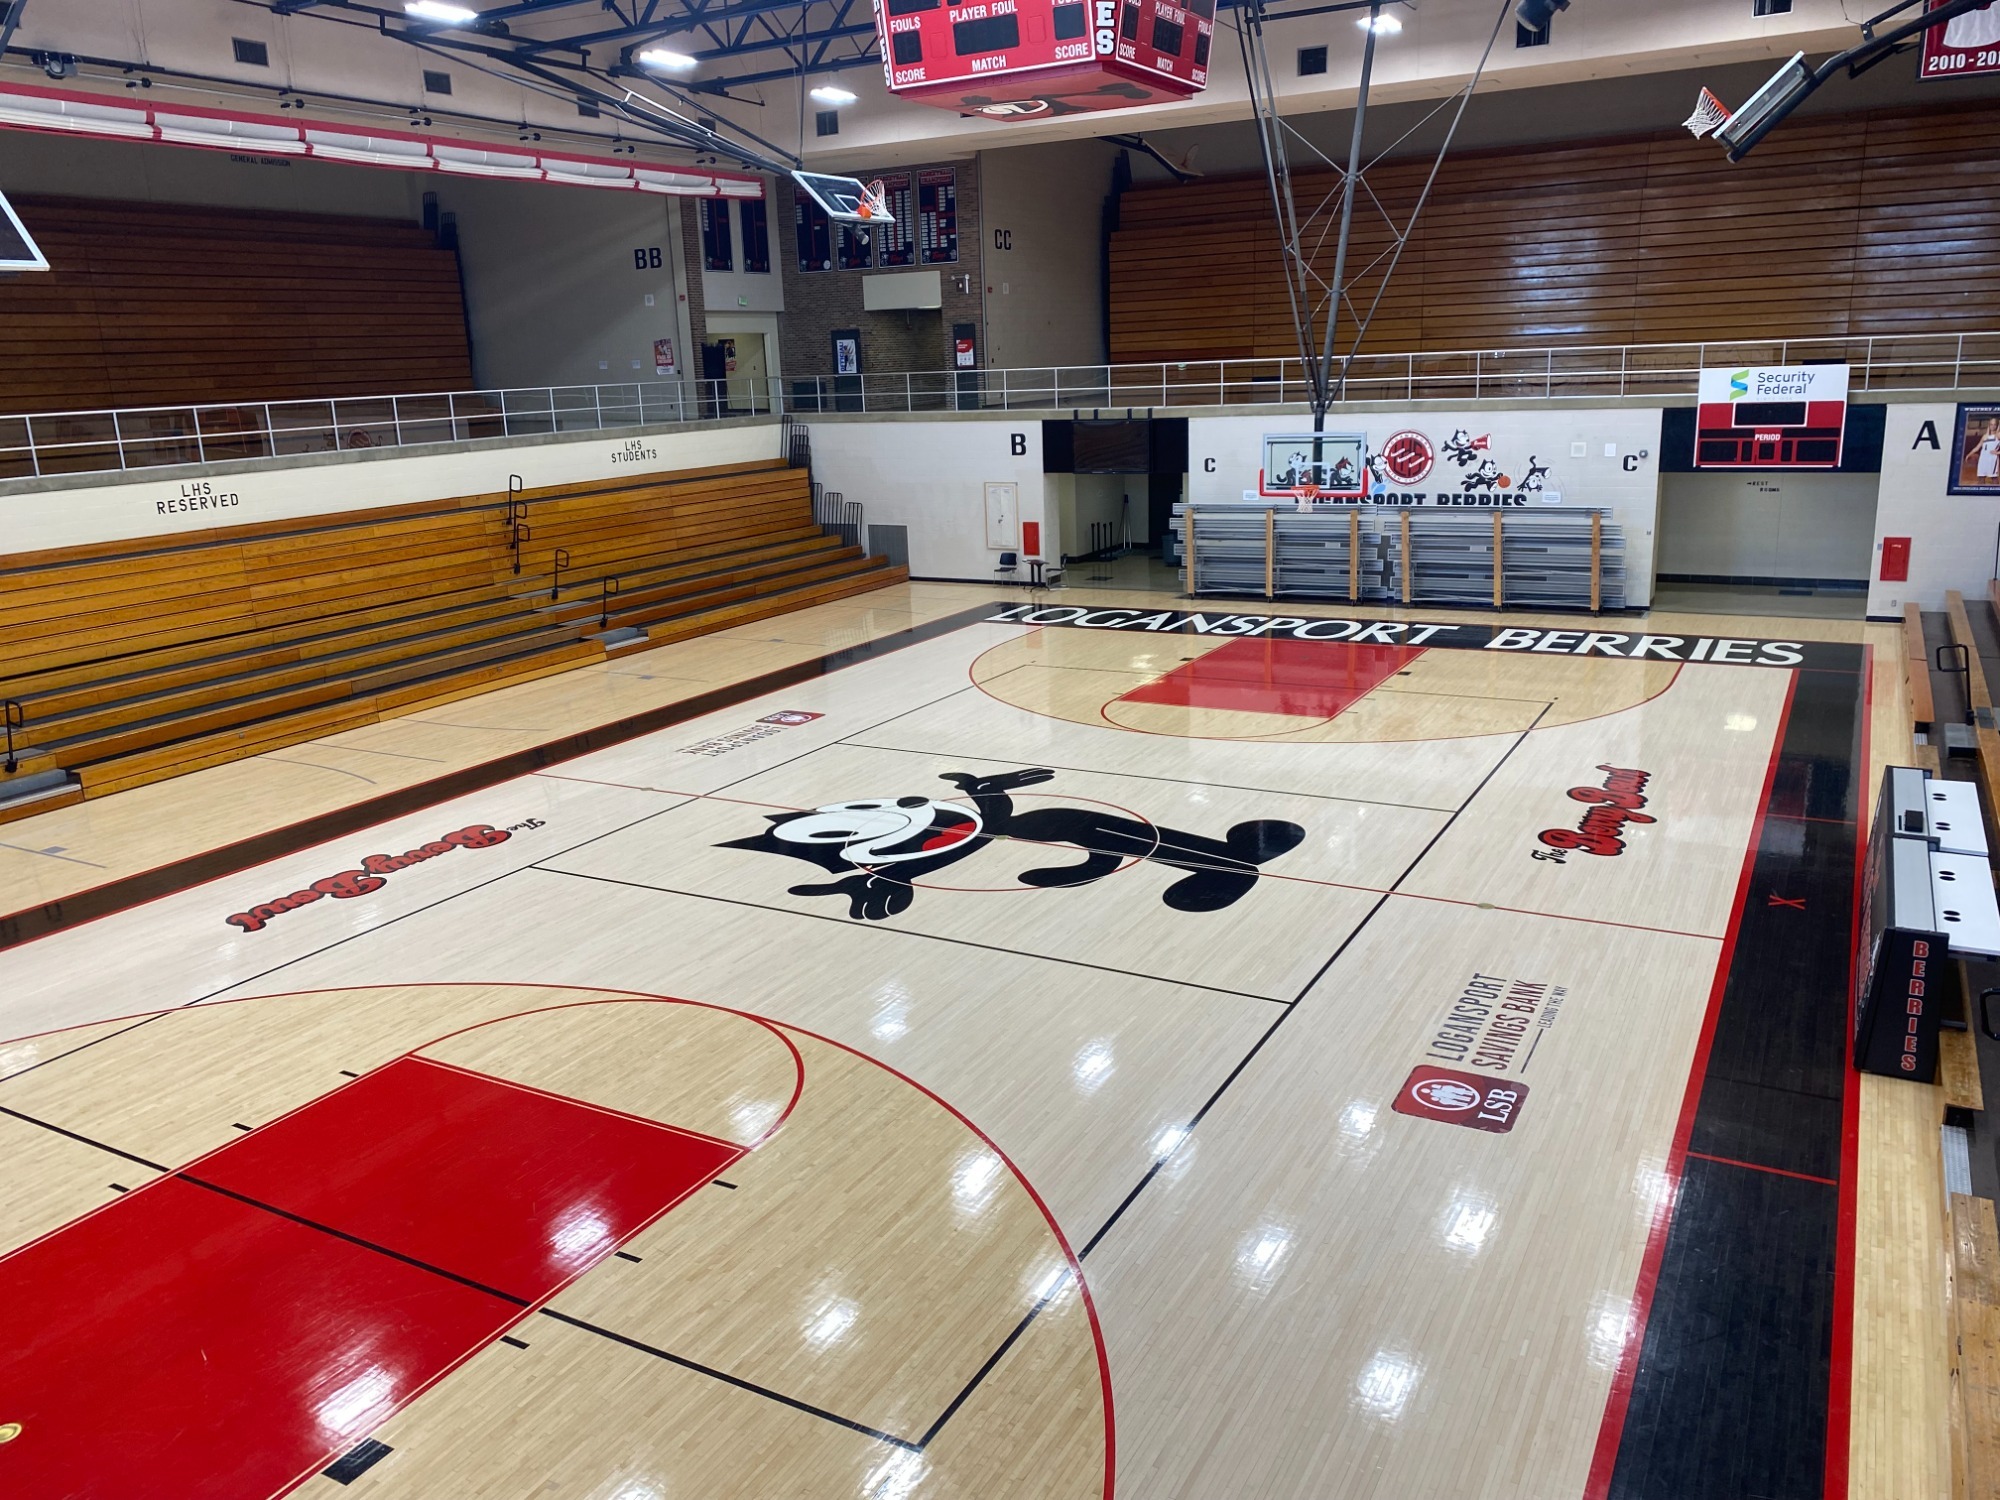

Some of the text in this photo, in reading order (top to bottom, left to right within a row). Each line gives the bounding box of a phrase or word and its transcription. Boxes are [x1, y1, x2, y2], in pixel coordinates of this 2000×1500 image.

[949, 0, 1018, 22] PLAYER FOUL
[1154, 3, 1186, 25] PLAYER FOUL
[890, 16, 921, 32] FOULS
[1198, 20, 1212, 36] FOULS
[1055, 43, 1089, 59] SCORE
[1119, 43, 1136, 60] SCORE
[971, 56, 1007, 72] MATCH
[1157, 56, 1174, 72] MATCH
[1928, 53, 1966, 71] 2010
[895, 67, 926, 84] SCORE
[1192, 68, 1206, 84] SCORE
[230, 154, 258, 164] GENERAL
[995, 229, 1011, 250] CC
[634, 247, 662, 270] BB
[1757, 371, 1816, 384] Security
[1757, 384, 1807, 395] Federal
[1754, 433, 1781, 441] PERIOD
[1911, 420, 1941, 450] A
[624, 440, 642, 451] LHS
[1011, 433, 1027, 456] B
[611, 449, 657, 463] STUDENTS
[1623, 455, 1638, 471] C
[1204, 457, 1216, 473] C
[181, 482, 211, 497] LHS
[156, 493, 239, 514] RESERVED
[984, 604, 1804, 666] LOGANSPORT BERRIES
[1537, 803, 1657, 856] Berry
[1531, 848, 1568, 864] The
[225, 817, 547, 933] The Berry Bowl
[1901, 940, 1929, 1071] BERRIES
[1426, 972, 1507, 1062] LOGANSPORT
[1470, 979, 1548, 1070] SAVINGS BANK
[1478, 1088, 1518, 1124] LSB
